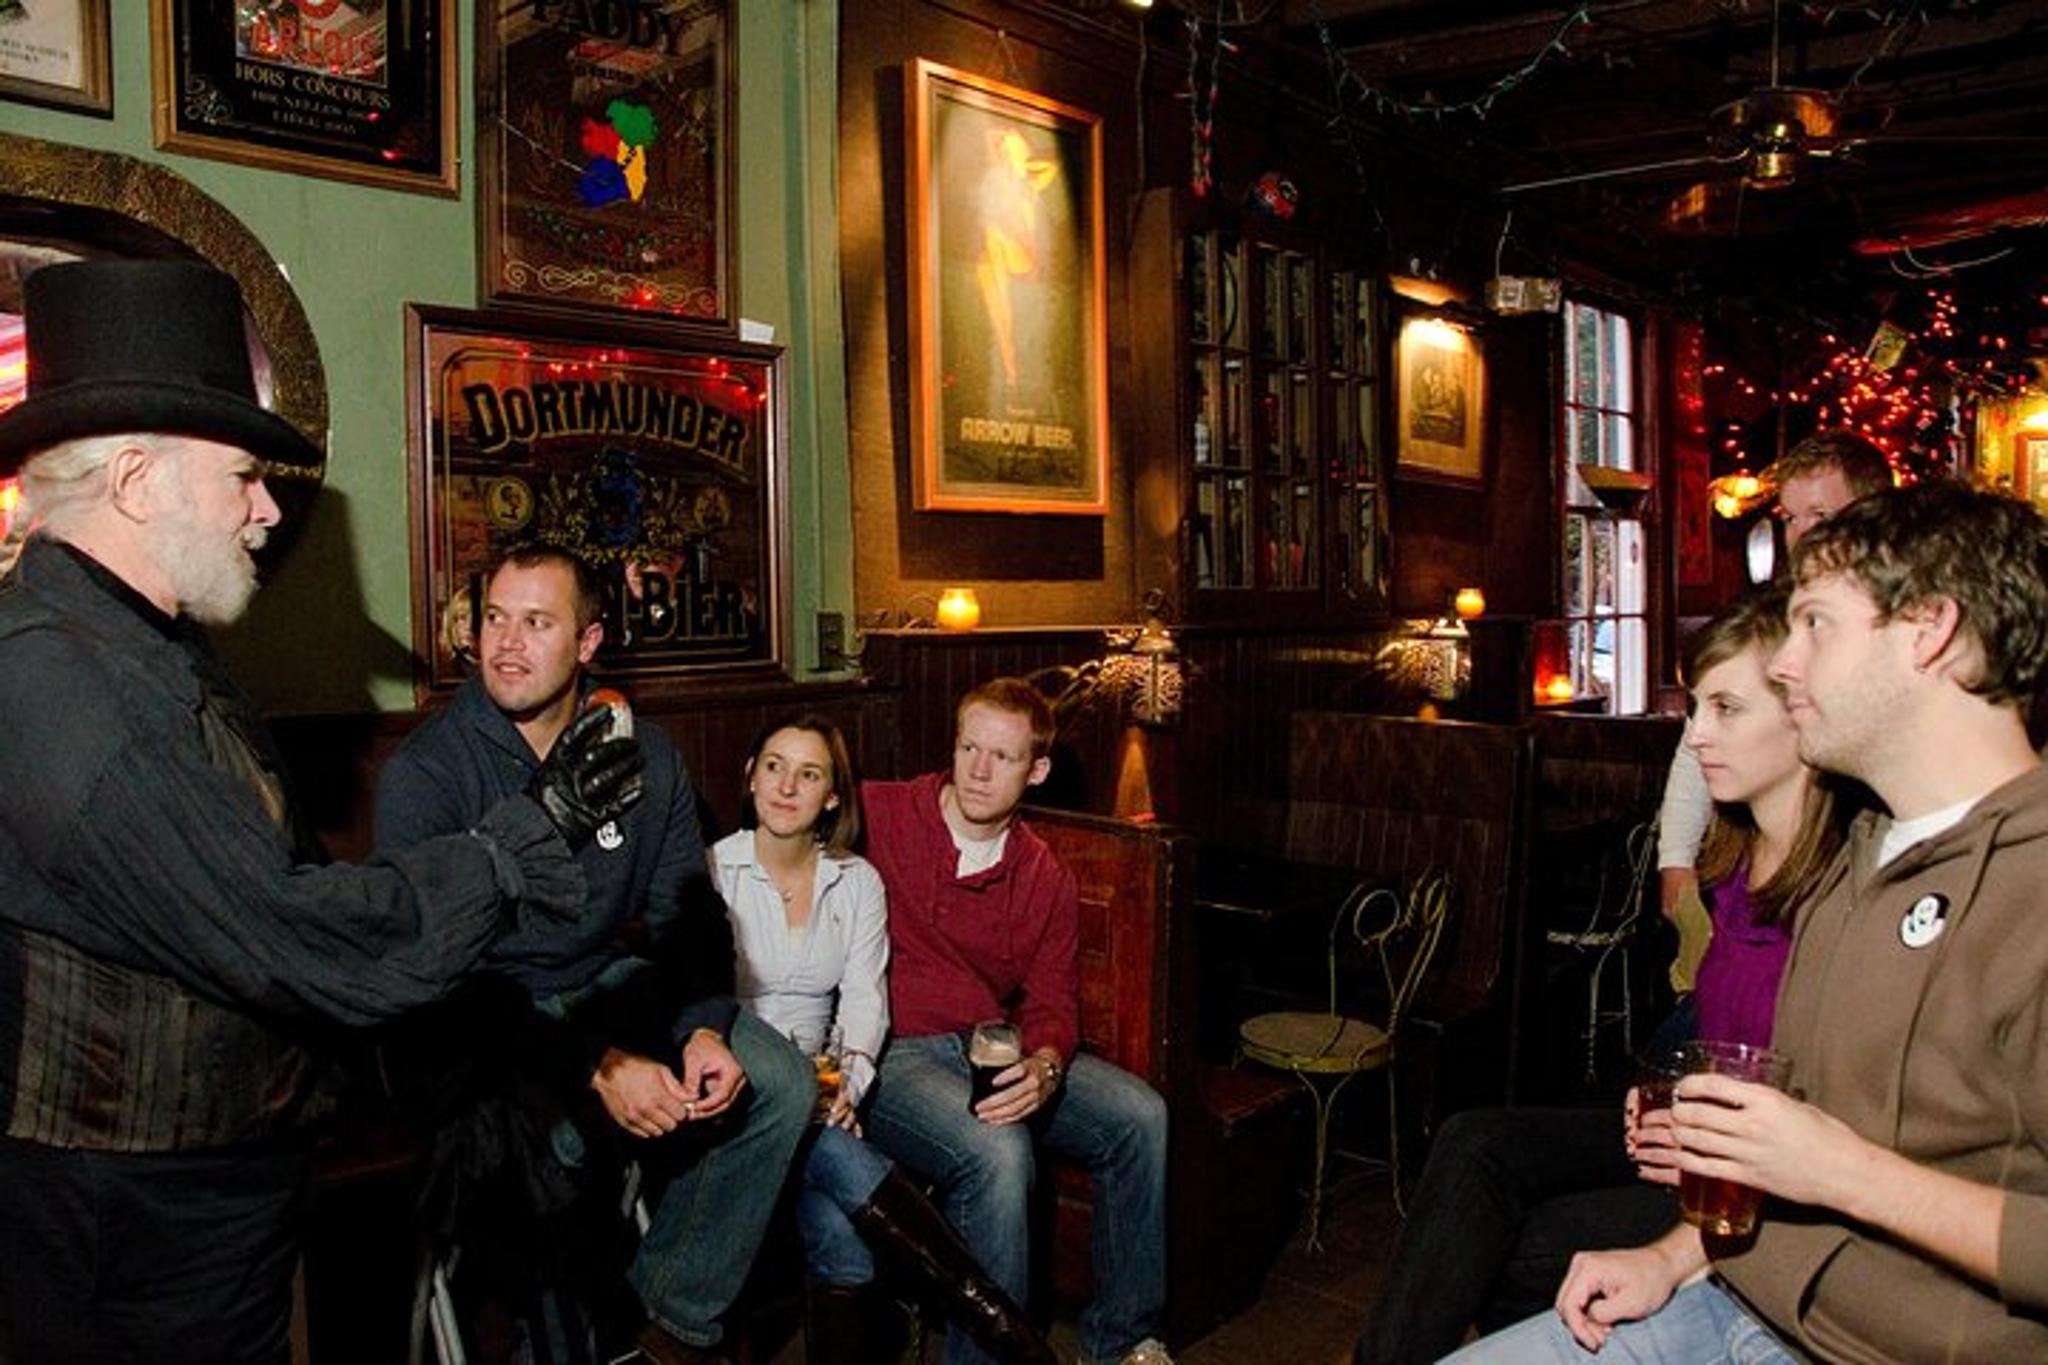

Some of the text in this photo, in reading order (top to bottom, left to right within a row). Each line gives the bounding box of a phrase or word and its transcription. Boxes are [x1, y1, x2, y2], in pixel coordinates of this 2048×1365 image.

[235, 61, 286, 89] HORS
[462, 379, 750, 471] DORTMUNDER
[960, 416, 1074, 448] ARROW BEER
